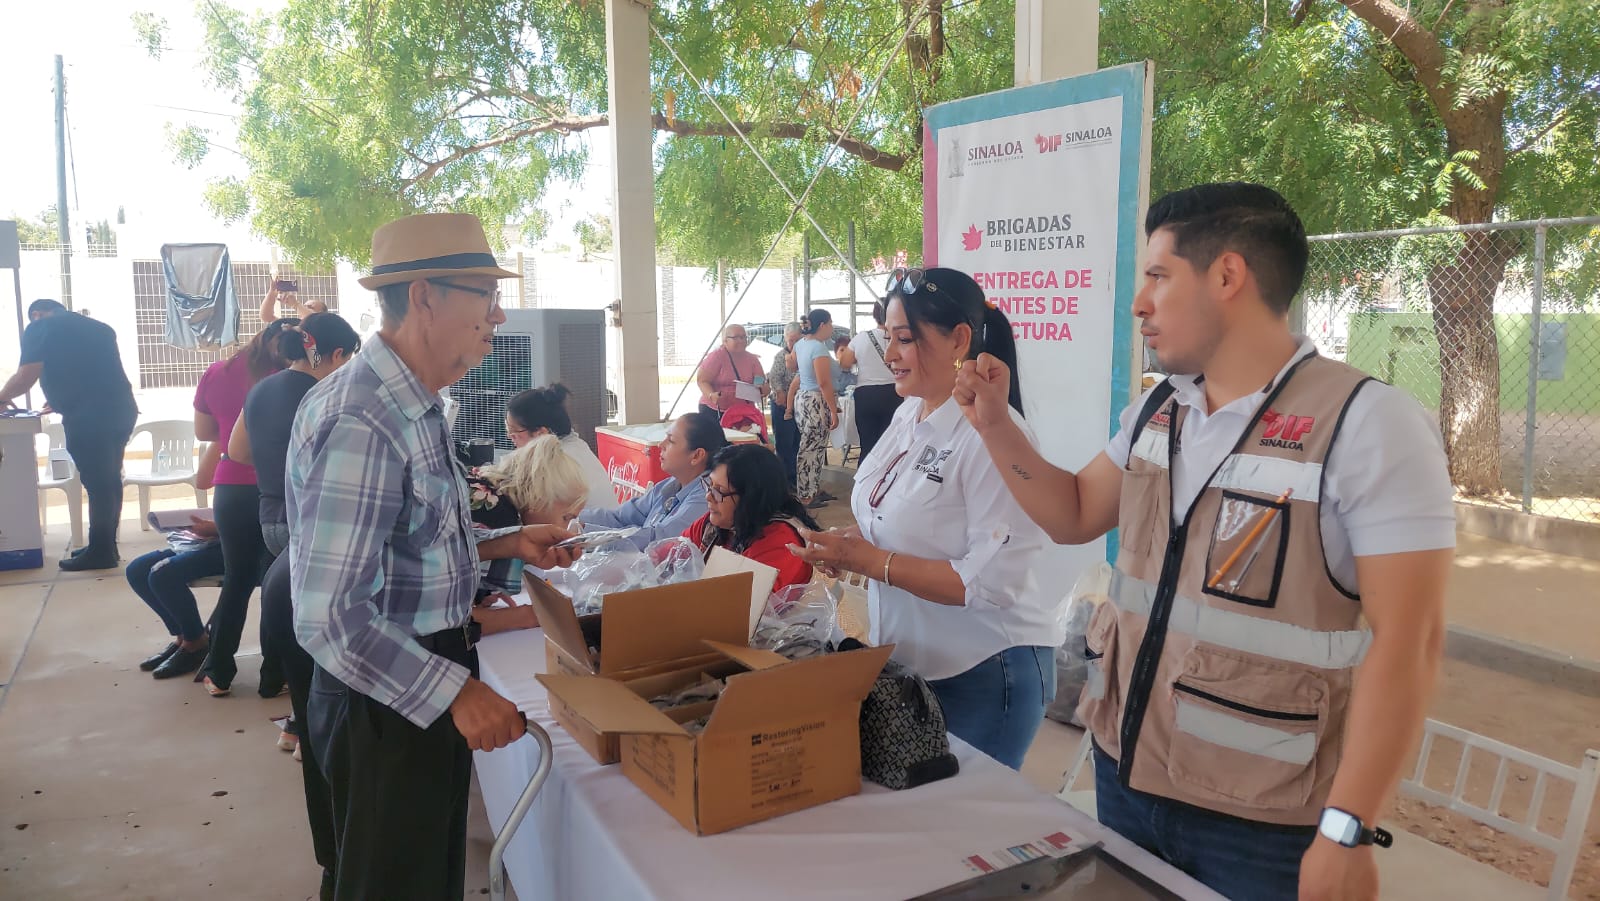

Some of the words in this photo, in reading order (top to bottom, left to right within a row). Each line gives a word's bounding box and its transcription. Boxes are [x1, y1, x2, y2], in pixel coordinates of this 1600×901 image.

[968, 140, 1023, 161] SINALOA
[1037, 133, 1062, 154] DIF
[1066, 126, 1112, 143] SINALOA
[987, 214, 1072, 236] BRIGADAS
[1004, 234, 1085, 252] BIENESTAR
[973, 270, 1059, 290] ENTREGA
[1064, 269, 1093, 289] DE
[988, 296, 1047, 315] ENTES
[1051, 296, 1079, 315] DE
[1011, 322, 1073, 341] CTURA
[1262, 411, 1315, 441] DIF
[1258, 438, 1304, 451] SINALOA
